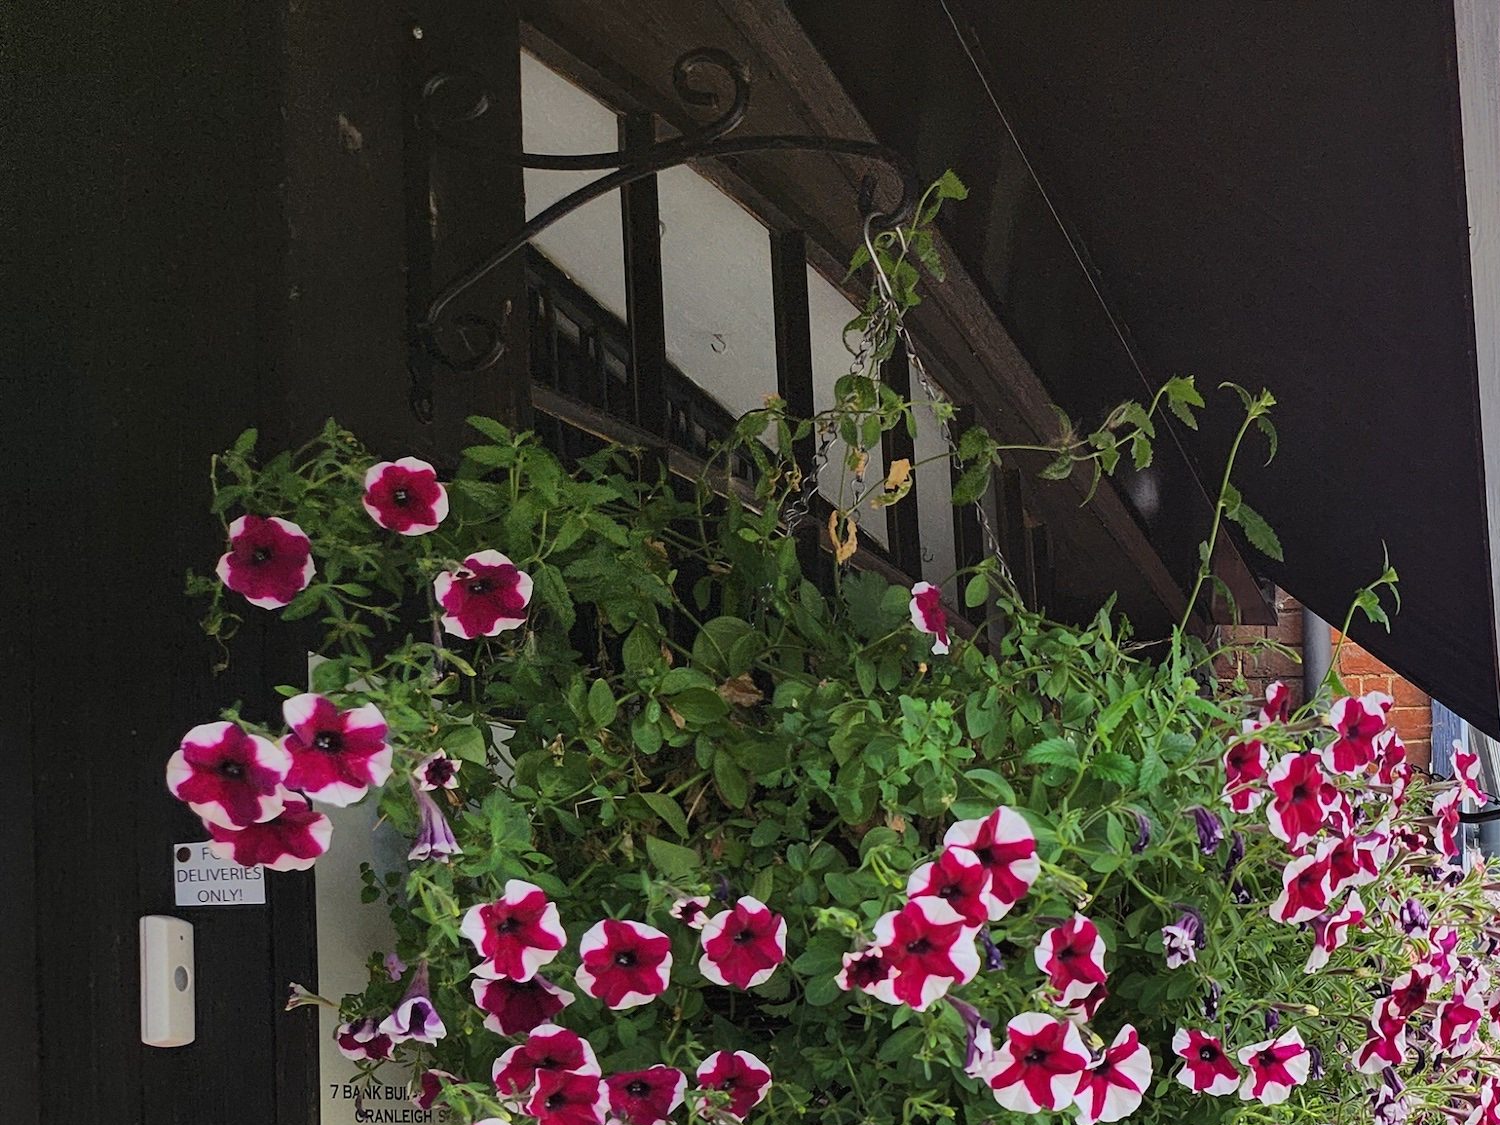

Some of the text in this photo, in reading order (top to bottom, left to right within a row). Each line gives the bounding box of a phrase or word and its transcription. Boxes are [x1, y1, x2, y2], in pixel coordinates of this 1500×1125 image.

[177, 866, 262, 883] DELIVERIES
[197, 889, 243, 903] ONLY!
[330, 1084, 340, 1099] 7
[342, 1084, 382, 1100] BANK
